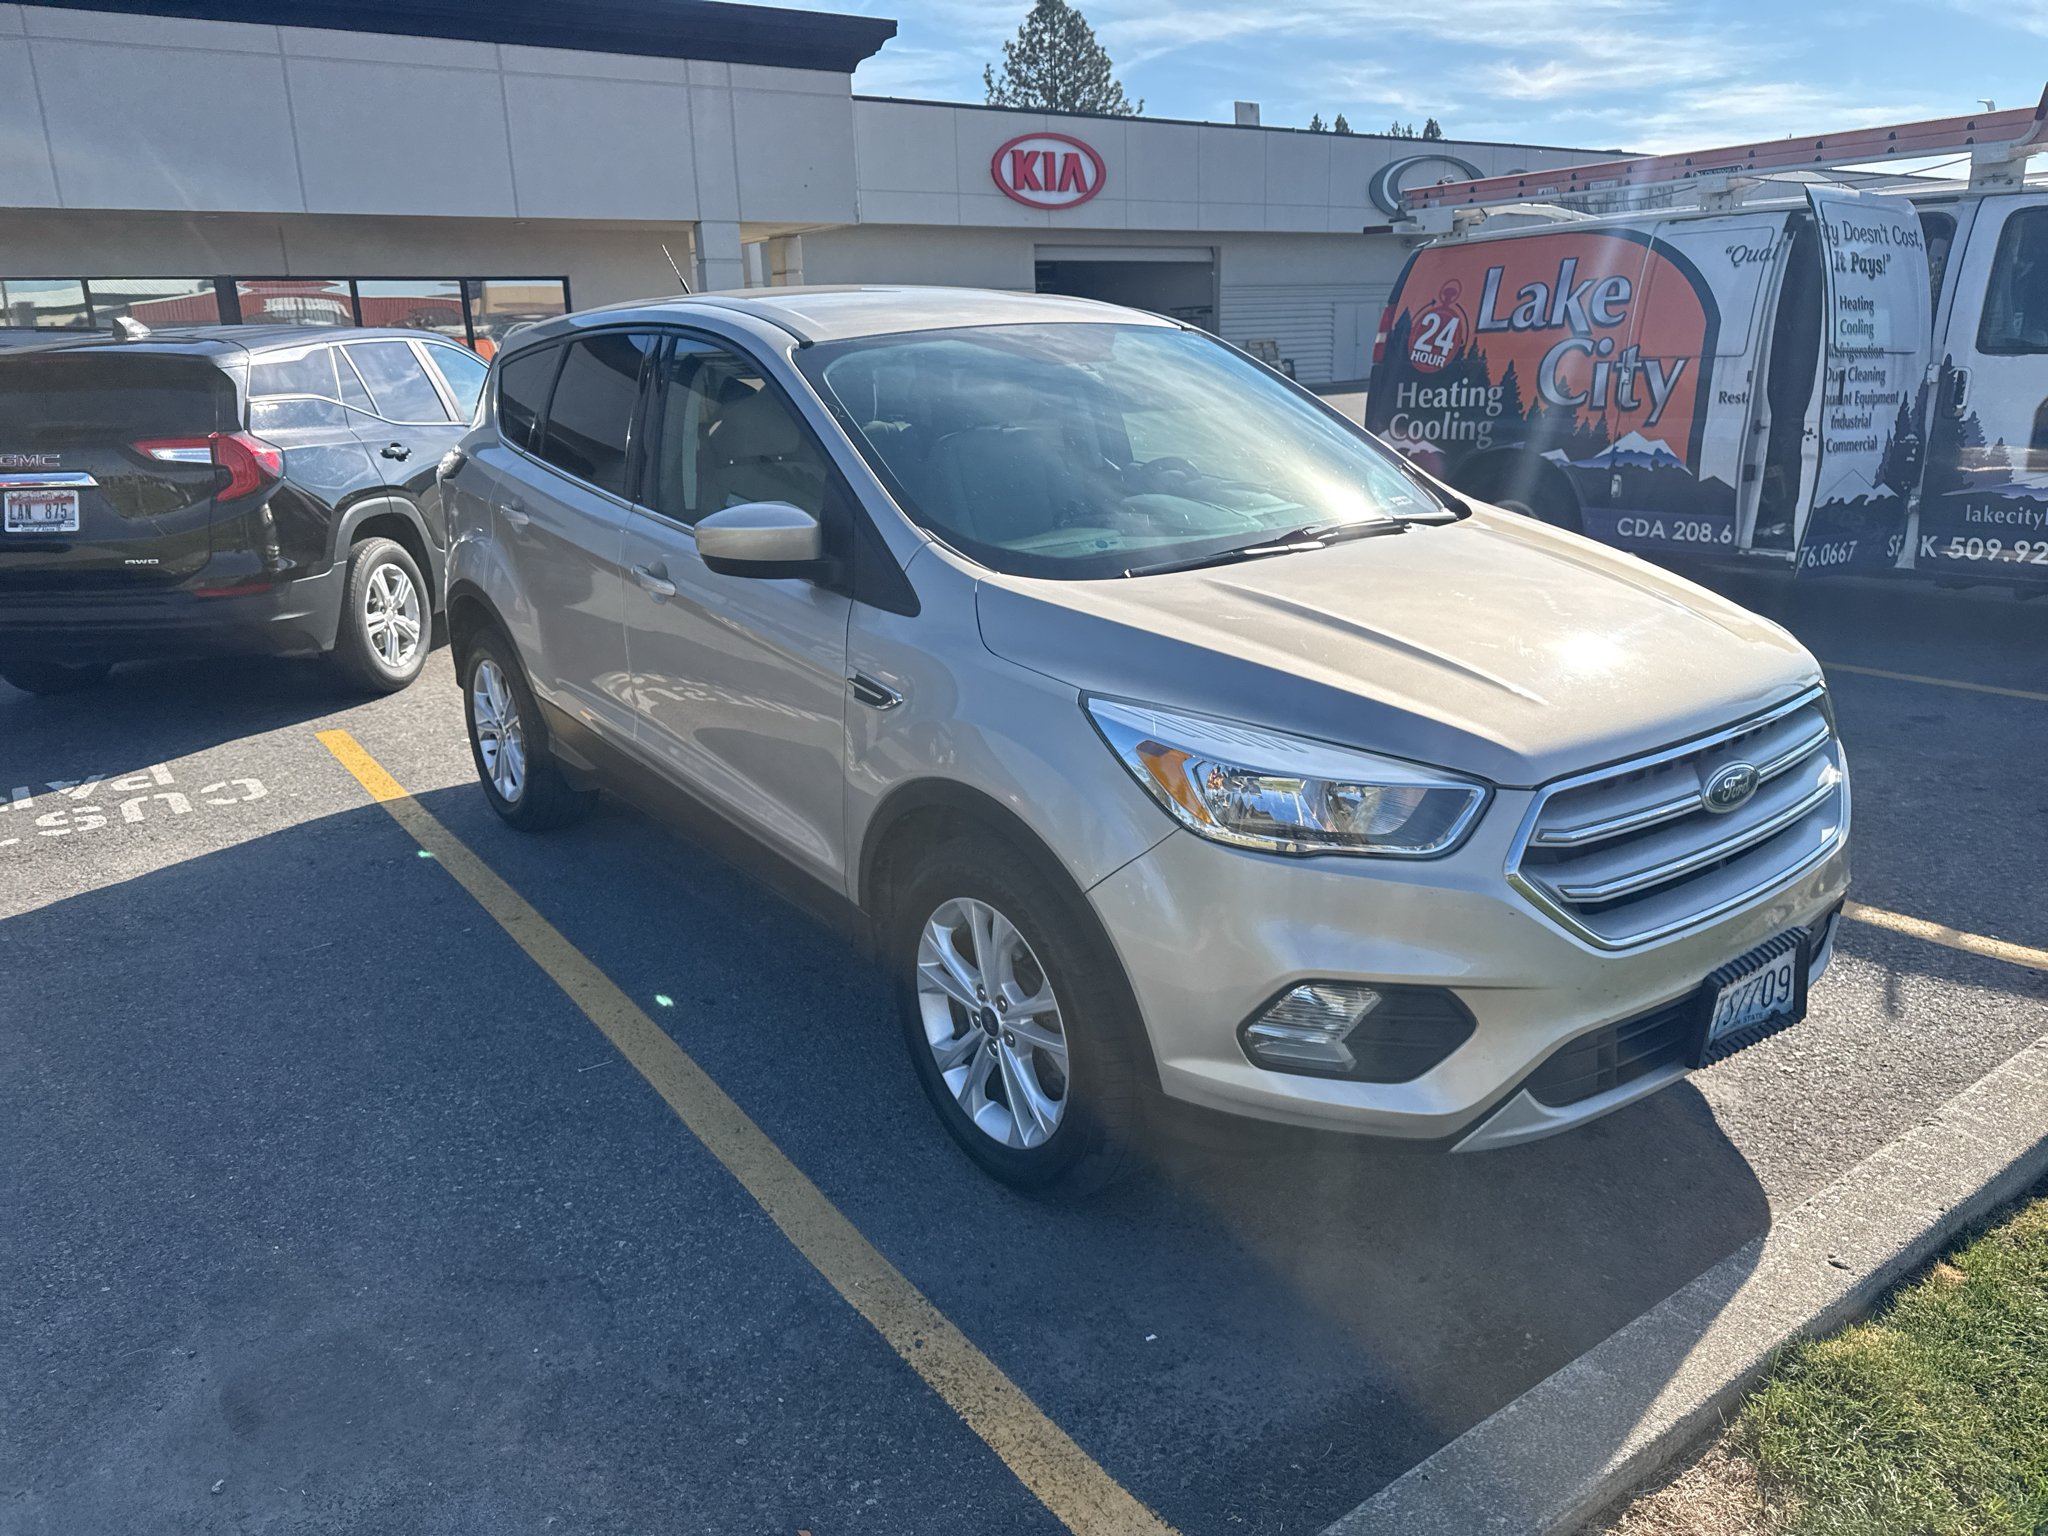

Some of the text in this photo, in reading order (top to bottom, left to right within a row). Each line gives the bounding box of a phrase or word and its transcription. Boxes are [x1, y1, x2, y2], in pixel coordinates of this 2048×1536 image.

[1011, 149, 1088, 193] KIA
[1842, 220, 1889, 246] Doesn't
[1892, 224, 1923, 251] Cost,
[1834, 250, 1846, 273] It
[1475, 257, 1632, 335] Lake
[1839, 295, 1875, 317] Heating
[1413, 312, 1460, 356] 24
[1840, 318, 1875, 340] Cooling
[1410, 350, 1446, 368] HOUR
[1536, 336, 1691, 427] City
[1848, 365, 1886, 387] Cleaning
[1396, 377, 1504, 416] Heating
[1855, 389, 1899, 411] Equipment
[1389, 411, 1494, 449] Cooling
[1830, 412, 1872, 430] Industrial
[1826, 434, 1878, 453] Commercial
[0, 454, 60, 467] GMC
[45, 503, 67, 520] 875
[1965, 504, 2048, 531] lakecity
[1617, 517, 1732, 544] CDA 208.6
[1799, 540, 1858, 568] 76.0667
[1920, 535, 1938, 558] K
[1722, 774, 1750, 801] Ford
[0, 777, 268, 846] CUS
